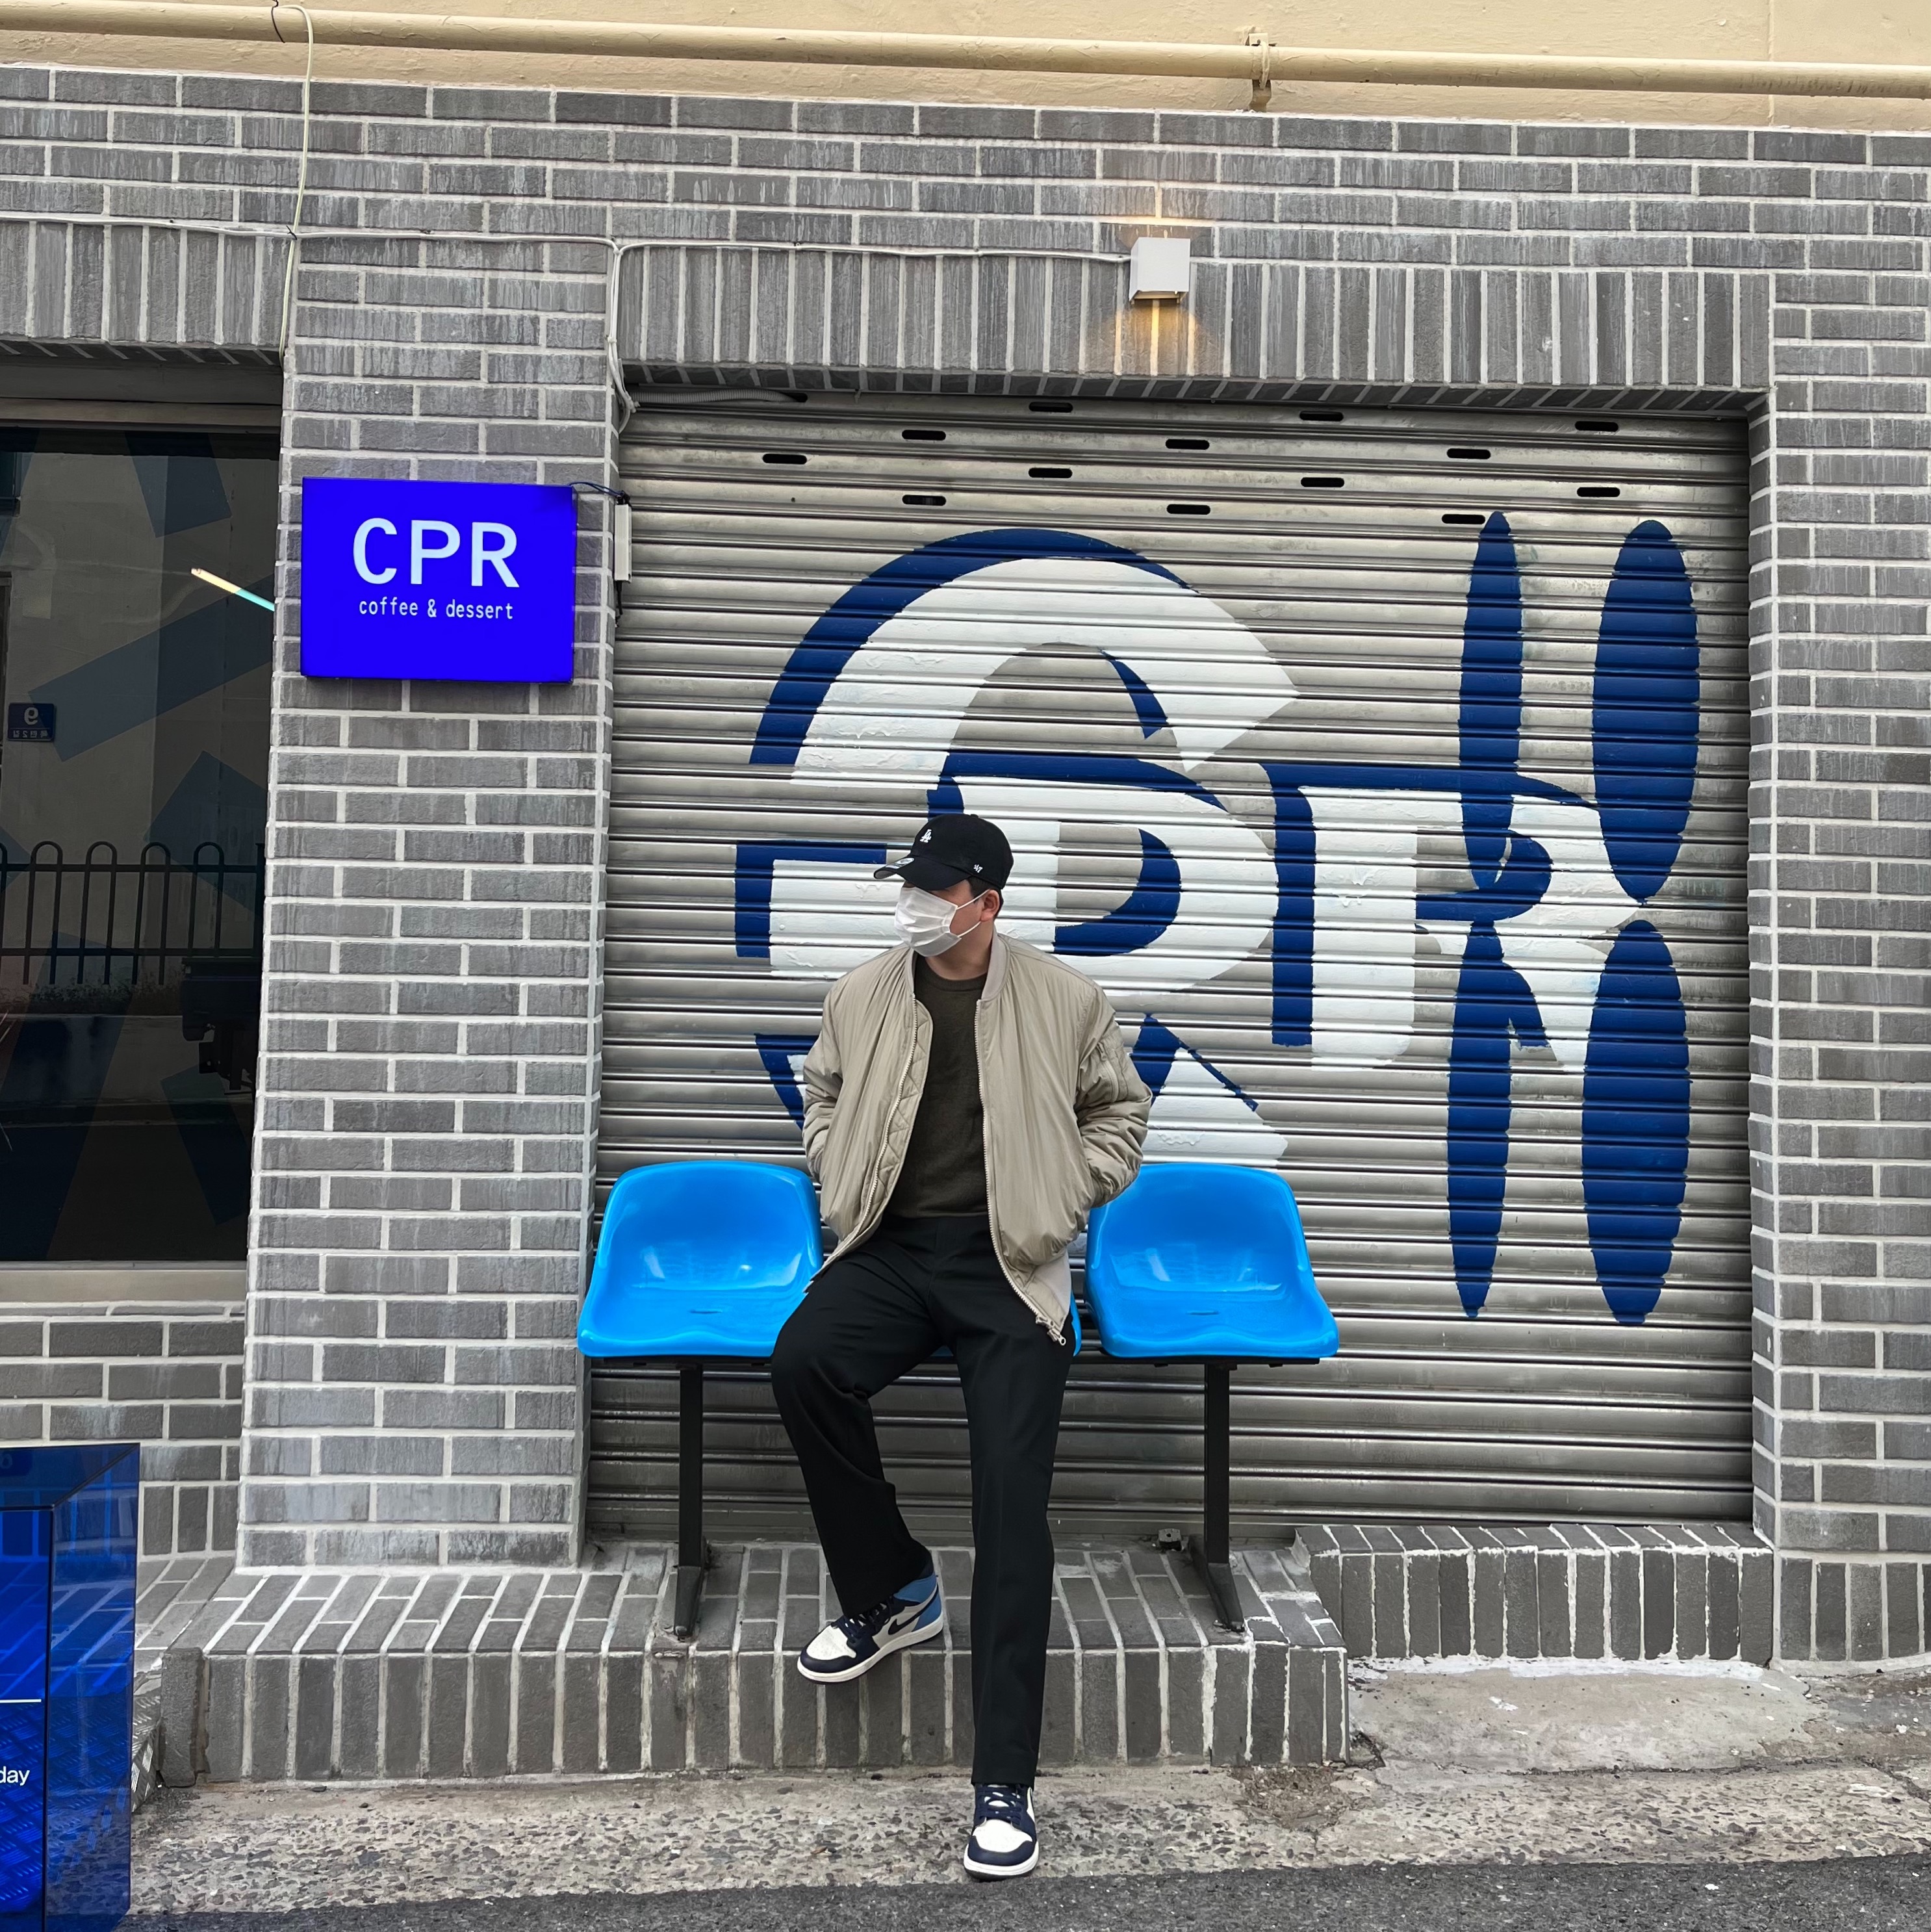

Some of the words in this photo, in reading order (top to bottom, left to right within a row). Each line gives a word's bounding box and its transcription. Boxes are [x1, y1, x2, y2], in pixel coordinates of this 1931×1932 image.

[353, 517, 520, 587] CPR
[359, 597, 418, 615] coffee
[427, 599, 437, 618] &
[446, 599, 513, 619] dessert
[919, 829, 932, 843] LA
